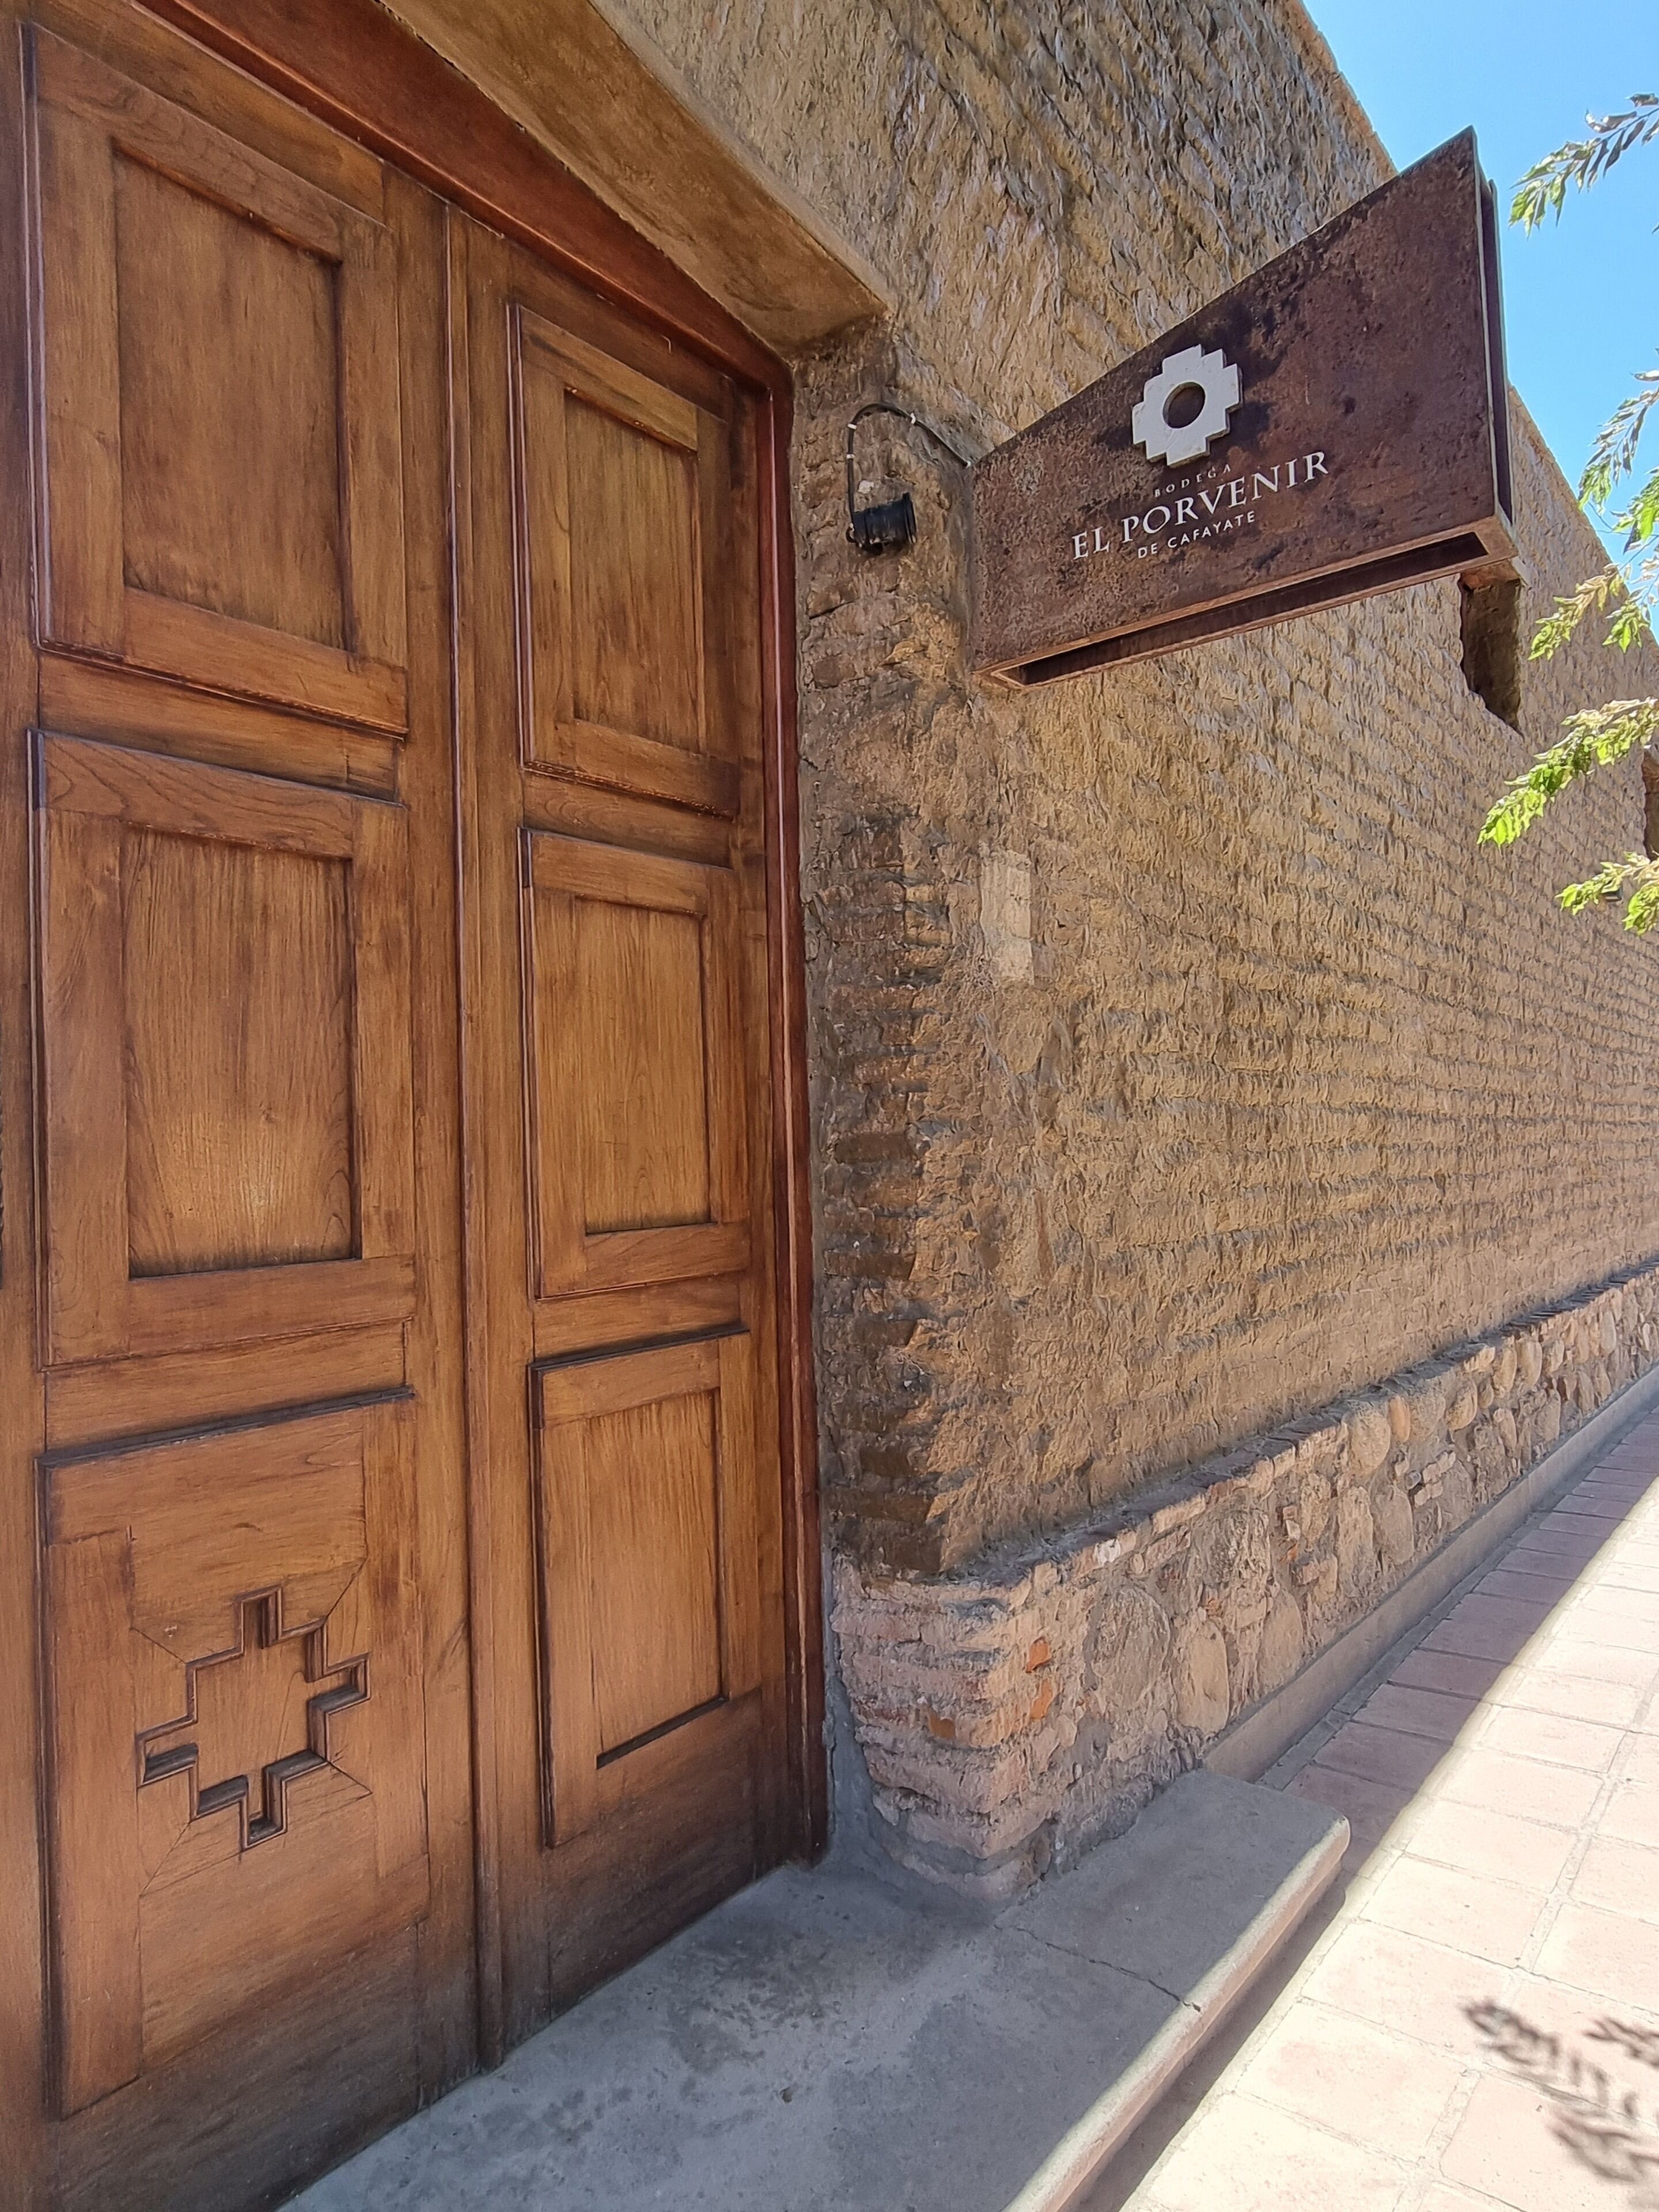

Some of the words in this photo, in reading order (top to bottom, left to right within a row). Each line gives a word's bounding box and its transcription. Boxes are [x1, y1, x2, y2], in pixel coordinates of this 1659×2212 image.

[1071, 525, 1110, 560] EL
[1121, 451, 1329, 544] PORVENIR
[1154, 464, 1232, 498] BODEGA
[1138, 543, 1158, 559] DE
[1168, 510, 1255, 549] CAFAYATE
